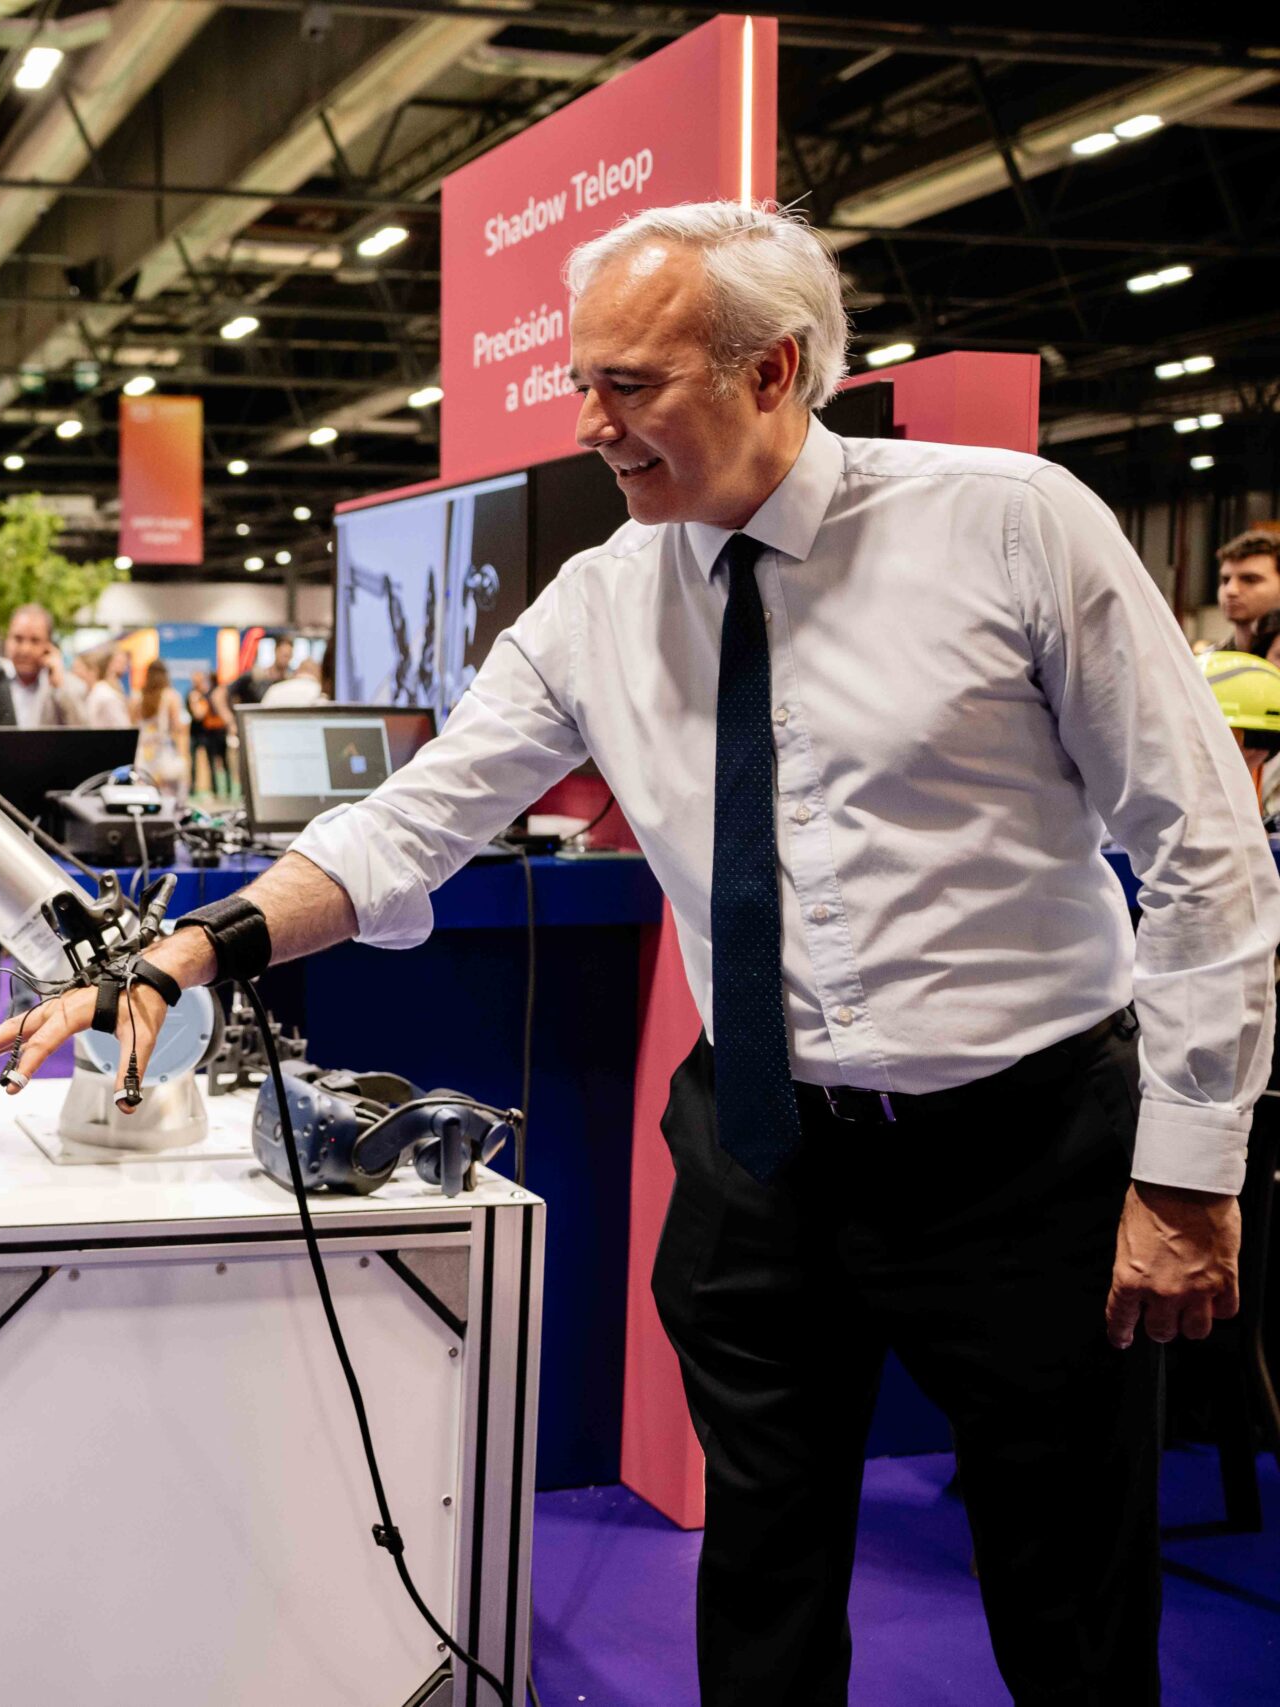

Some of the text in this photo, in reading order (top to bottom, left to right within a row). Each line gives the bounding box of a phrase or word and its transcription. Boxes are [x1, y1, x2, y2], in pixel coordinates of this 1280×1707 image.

[484, 147, 654, 257] Shadow Teleop
[473, 303, 564, 369] Precisión
[505, 382, 519, 412] a
